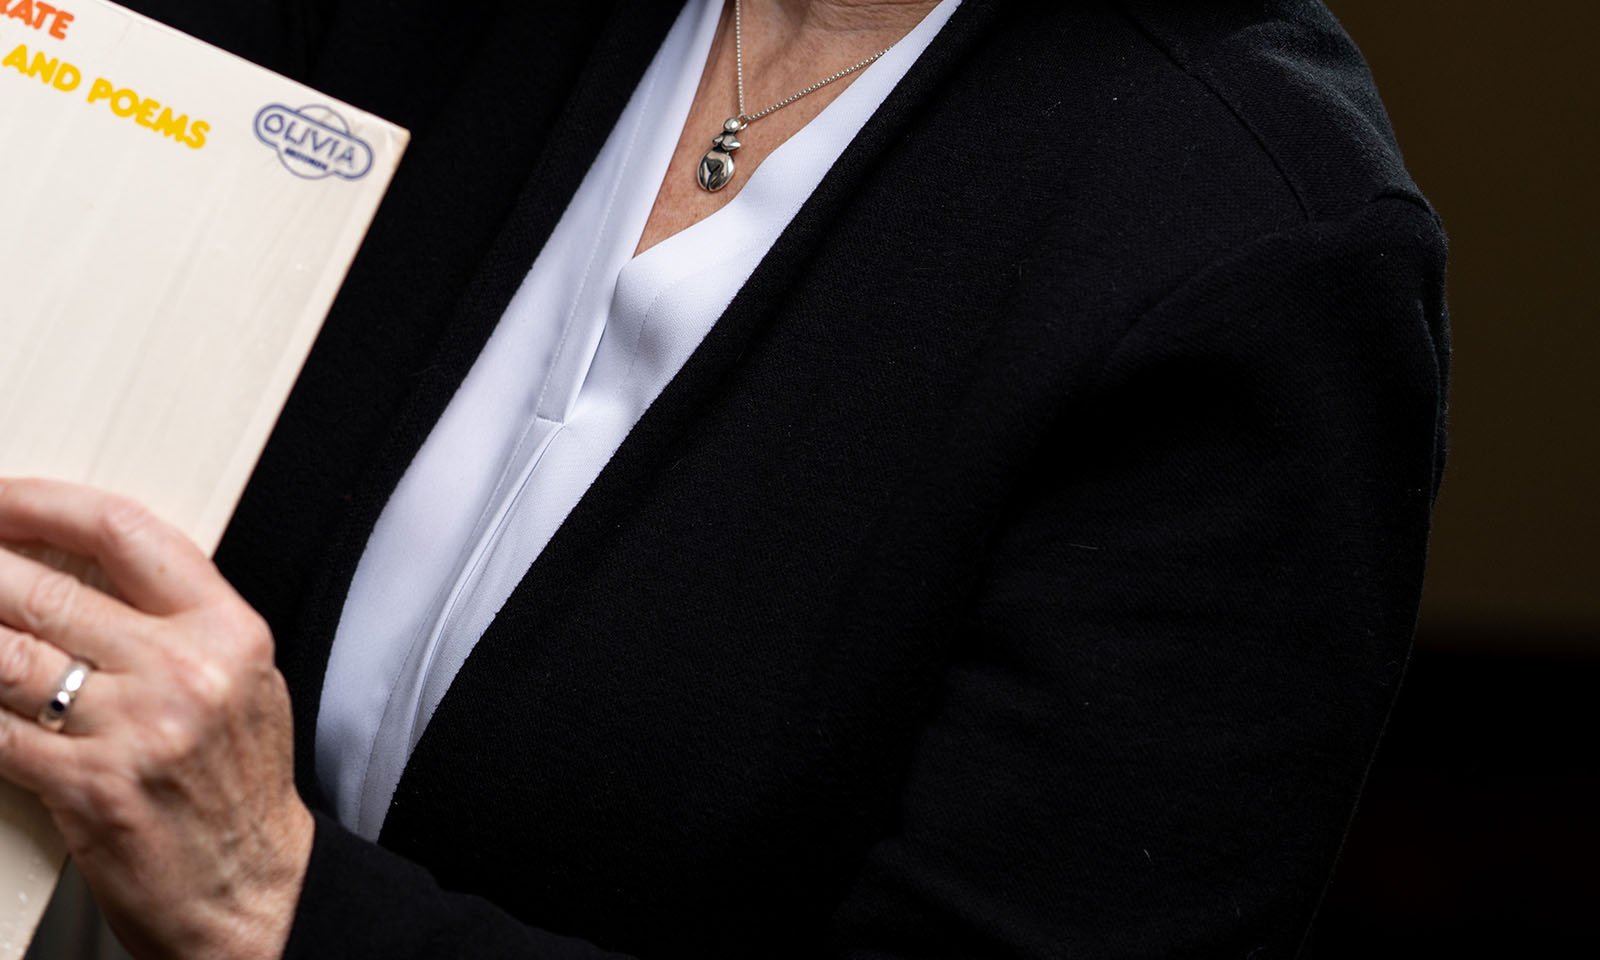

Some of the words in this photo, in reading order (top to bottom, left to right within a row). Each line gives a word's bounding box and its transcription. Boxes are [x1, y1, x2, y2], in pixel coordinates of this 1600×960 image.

[1, 43, 82, 93] AND
[85, 77, 212, 150] POEMS
[263, 113, 355, 168] OLIVIA
